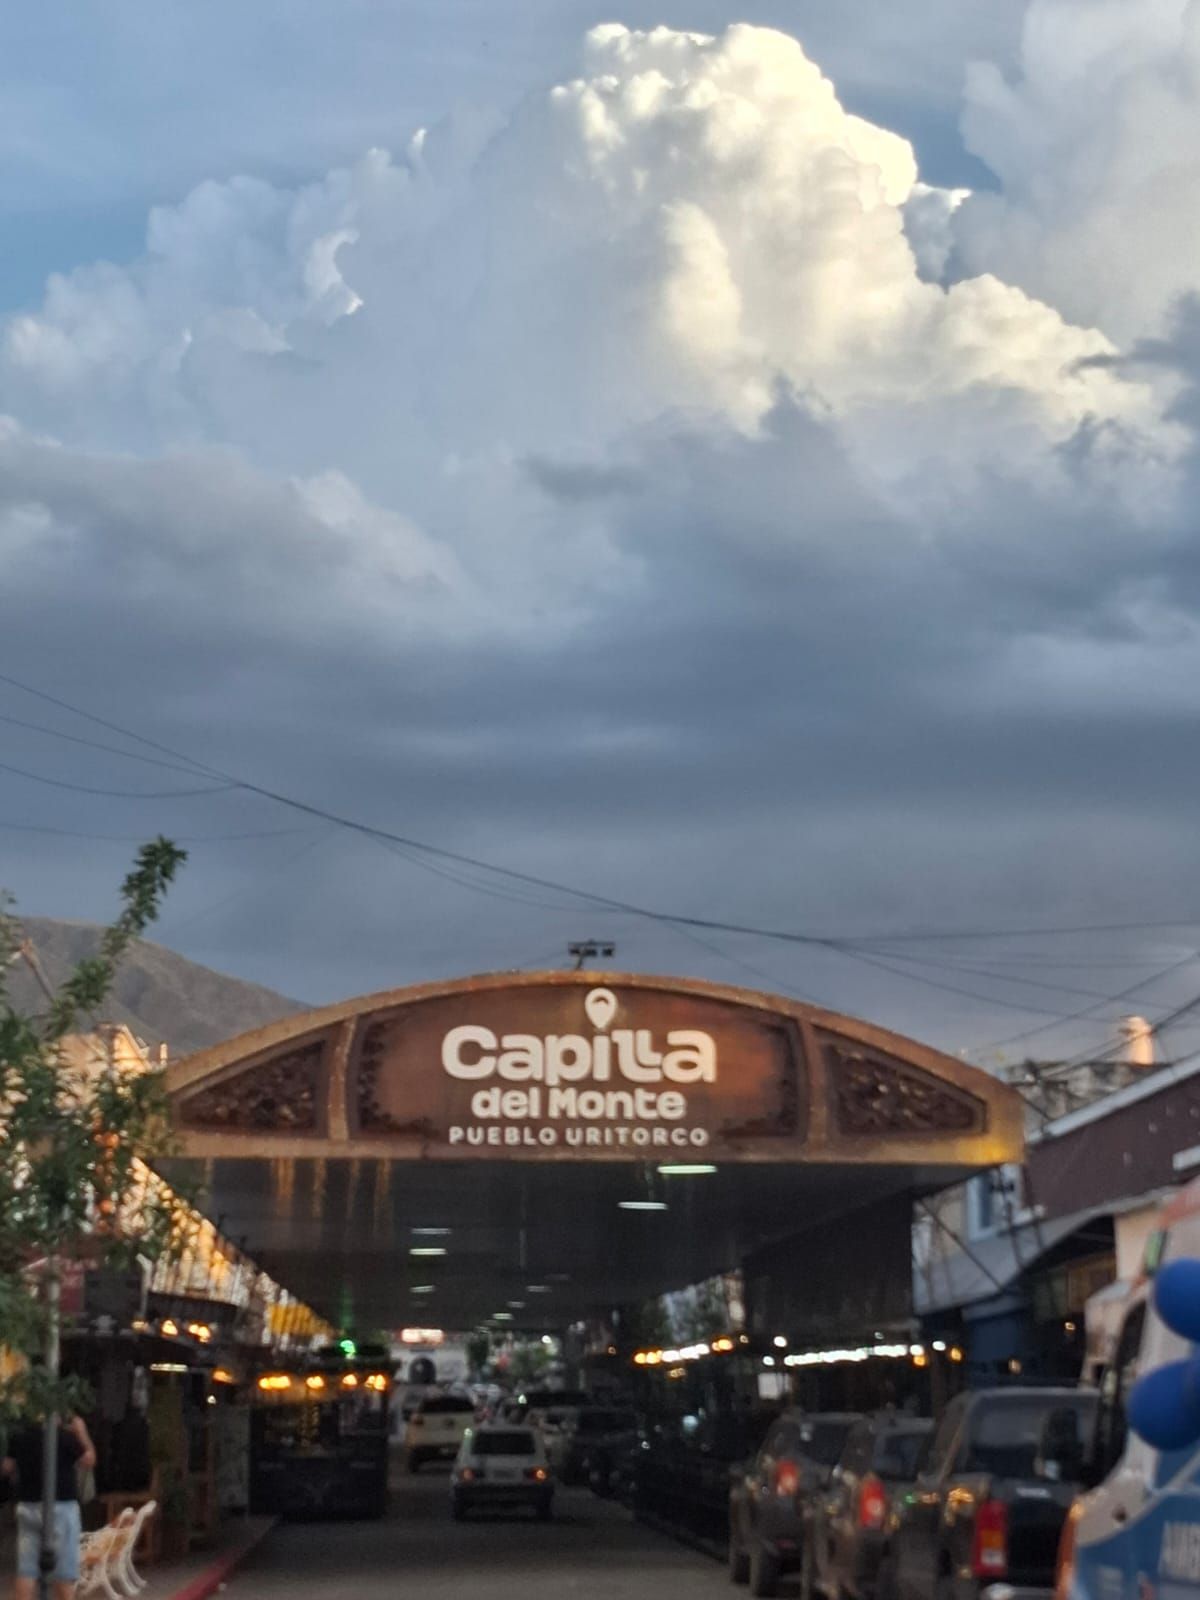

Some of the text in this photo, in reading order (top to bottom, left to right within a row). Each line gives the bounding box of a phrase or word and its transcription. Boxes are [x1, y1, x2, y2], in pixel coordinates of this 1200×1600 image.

[442, 1023, 717, 1086] Capilla
[470, 1087, 687, 1120] del Monte
[449, 1126, 709, 1147] PUEBLO URITORCO
